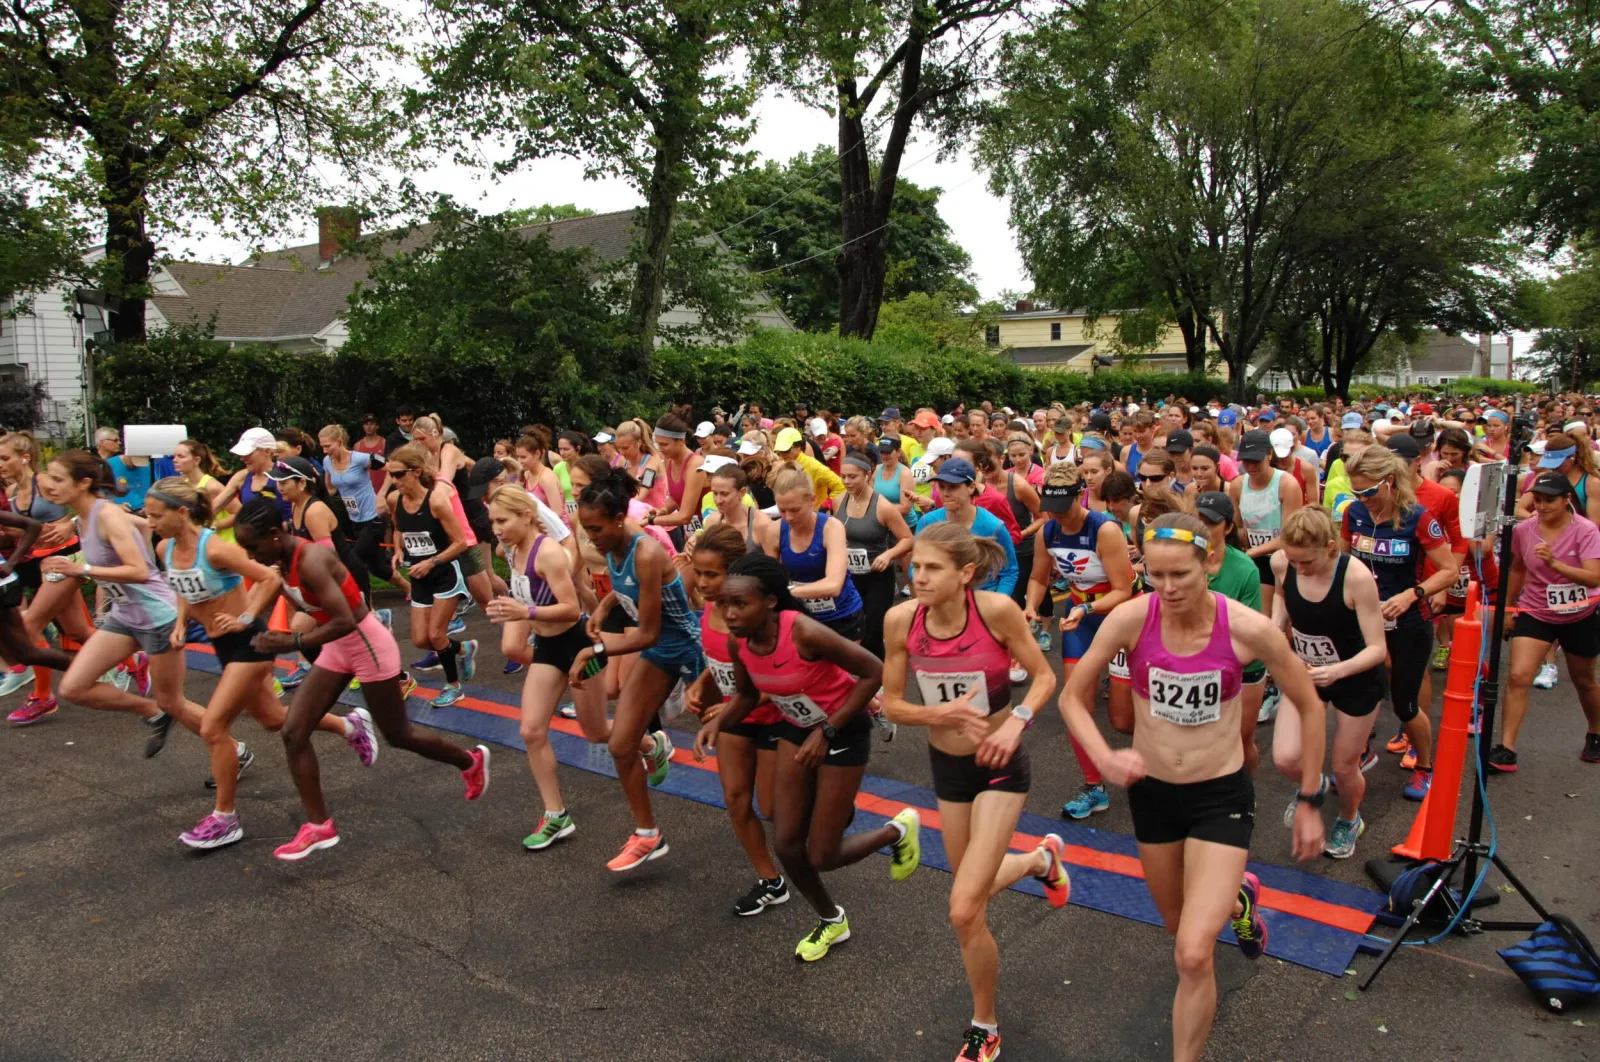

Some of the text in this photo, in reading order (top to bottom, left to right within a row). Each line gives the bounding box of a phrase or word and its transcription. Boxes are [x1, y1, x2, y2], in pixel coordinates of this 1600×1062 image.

[913, 469, 927, 478] 175
[405, 536, 433, 549] 3180
[1351, 534, 1407, 553] TEAM
[848, 554, 866, 566] 197
[1548, 587, 1587, 605] 5143
[1294, 636, 1335, 657] 1713
[937, 682, 968, 703] 16
[1151, 679, 1219, 709] 3249
